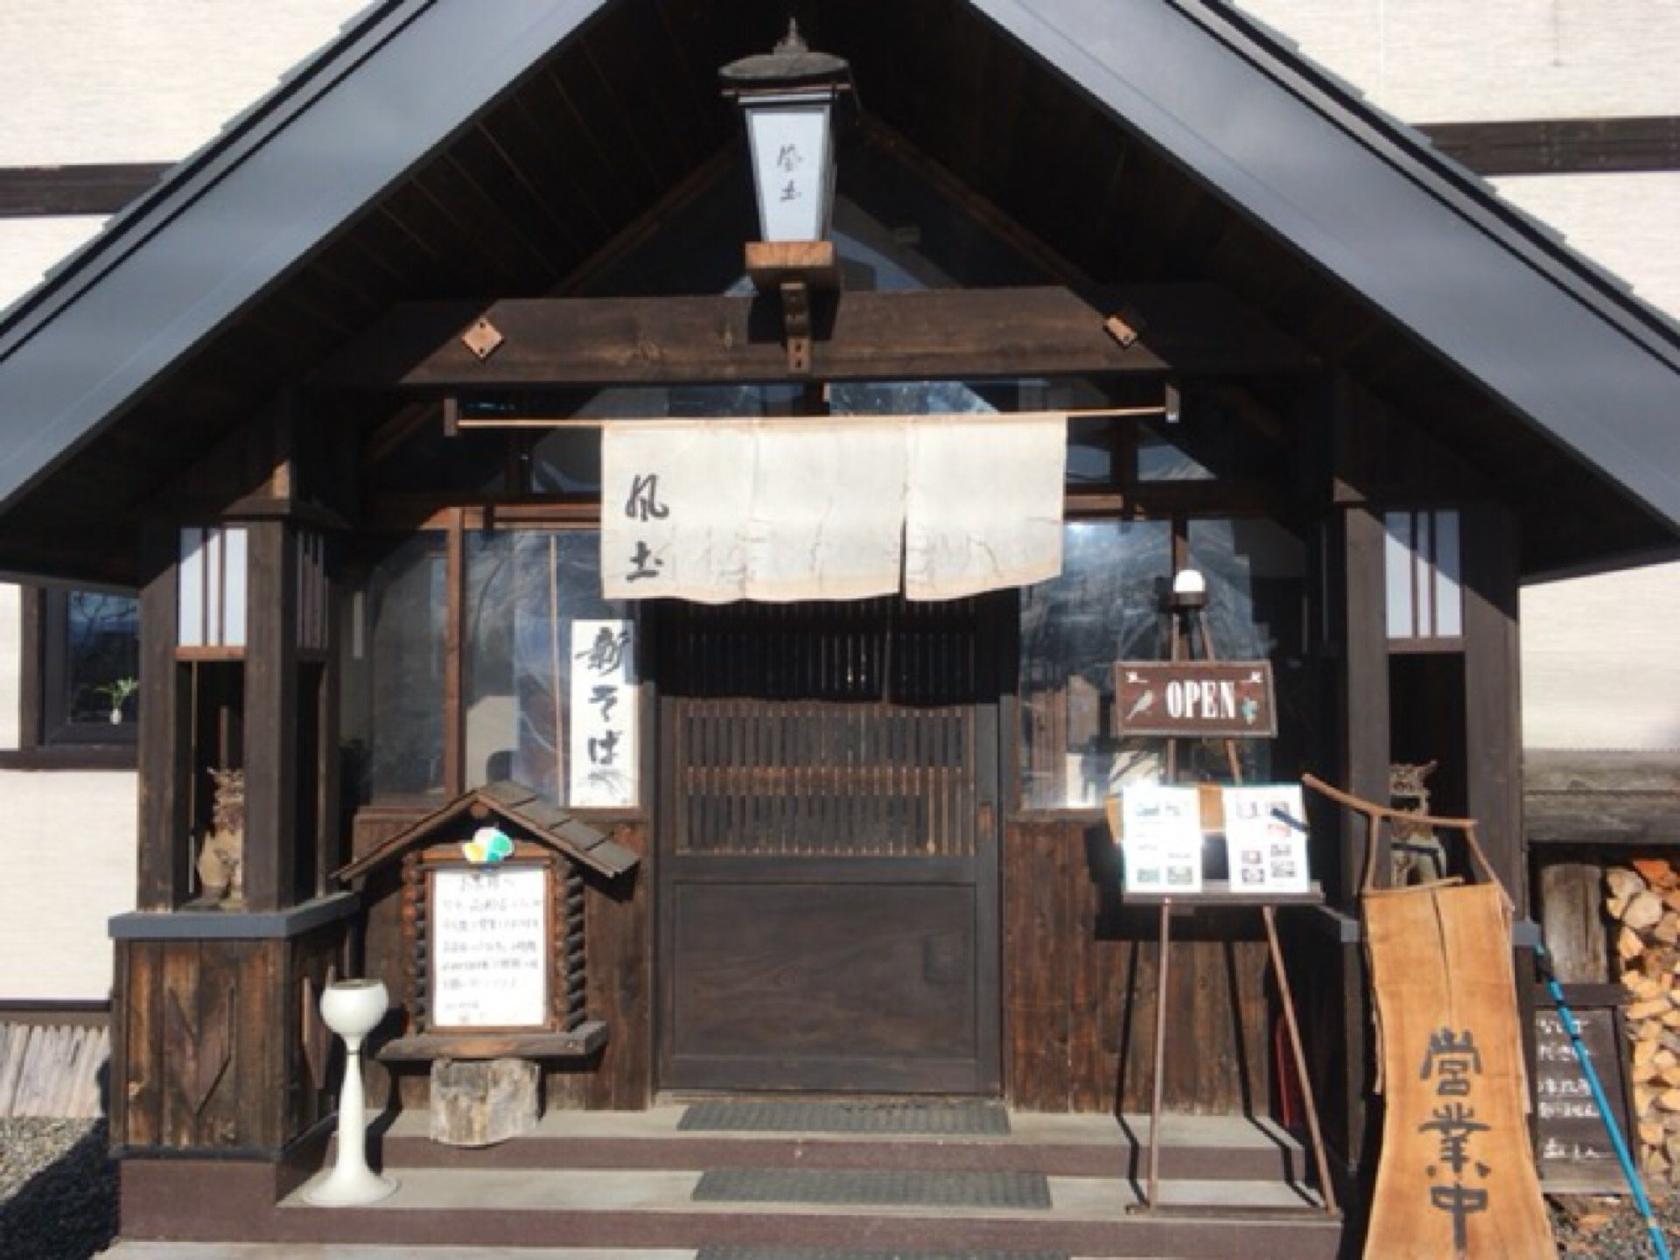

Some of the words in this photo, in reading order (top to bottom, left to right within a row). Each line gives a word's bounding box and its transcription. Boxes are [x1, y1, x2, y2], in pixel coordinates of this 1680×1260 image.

[624, 474, 670, 582] 風土
[574, 625, 631, 766] 新そば
[1165, 679, 1237, 719] OPEN
[1418, 1027, 1492, 1252] 営業中
